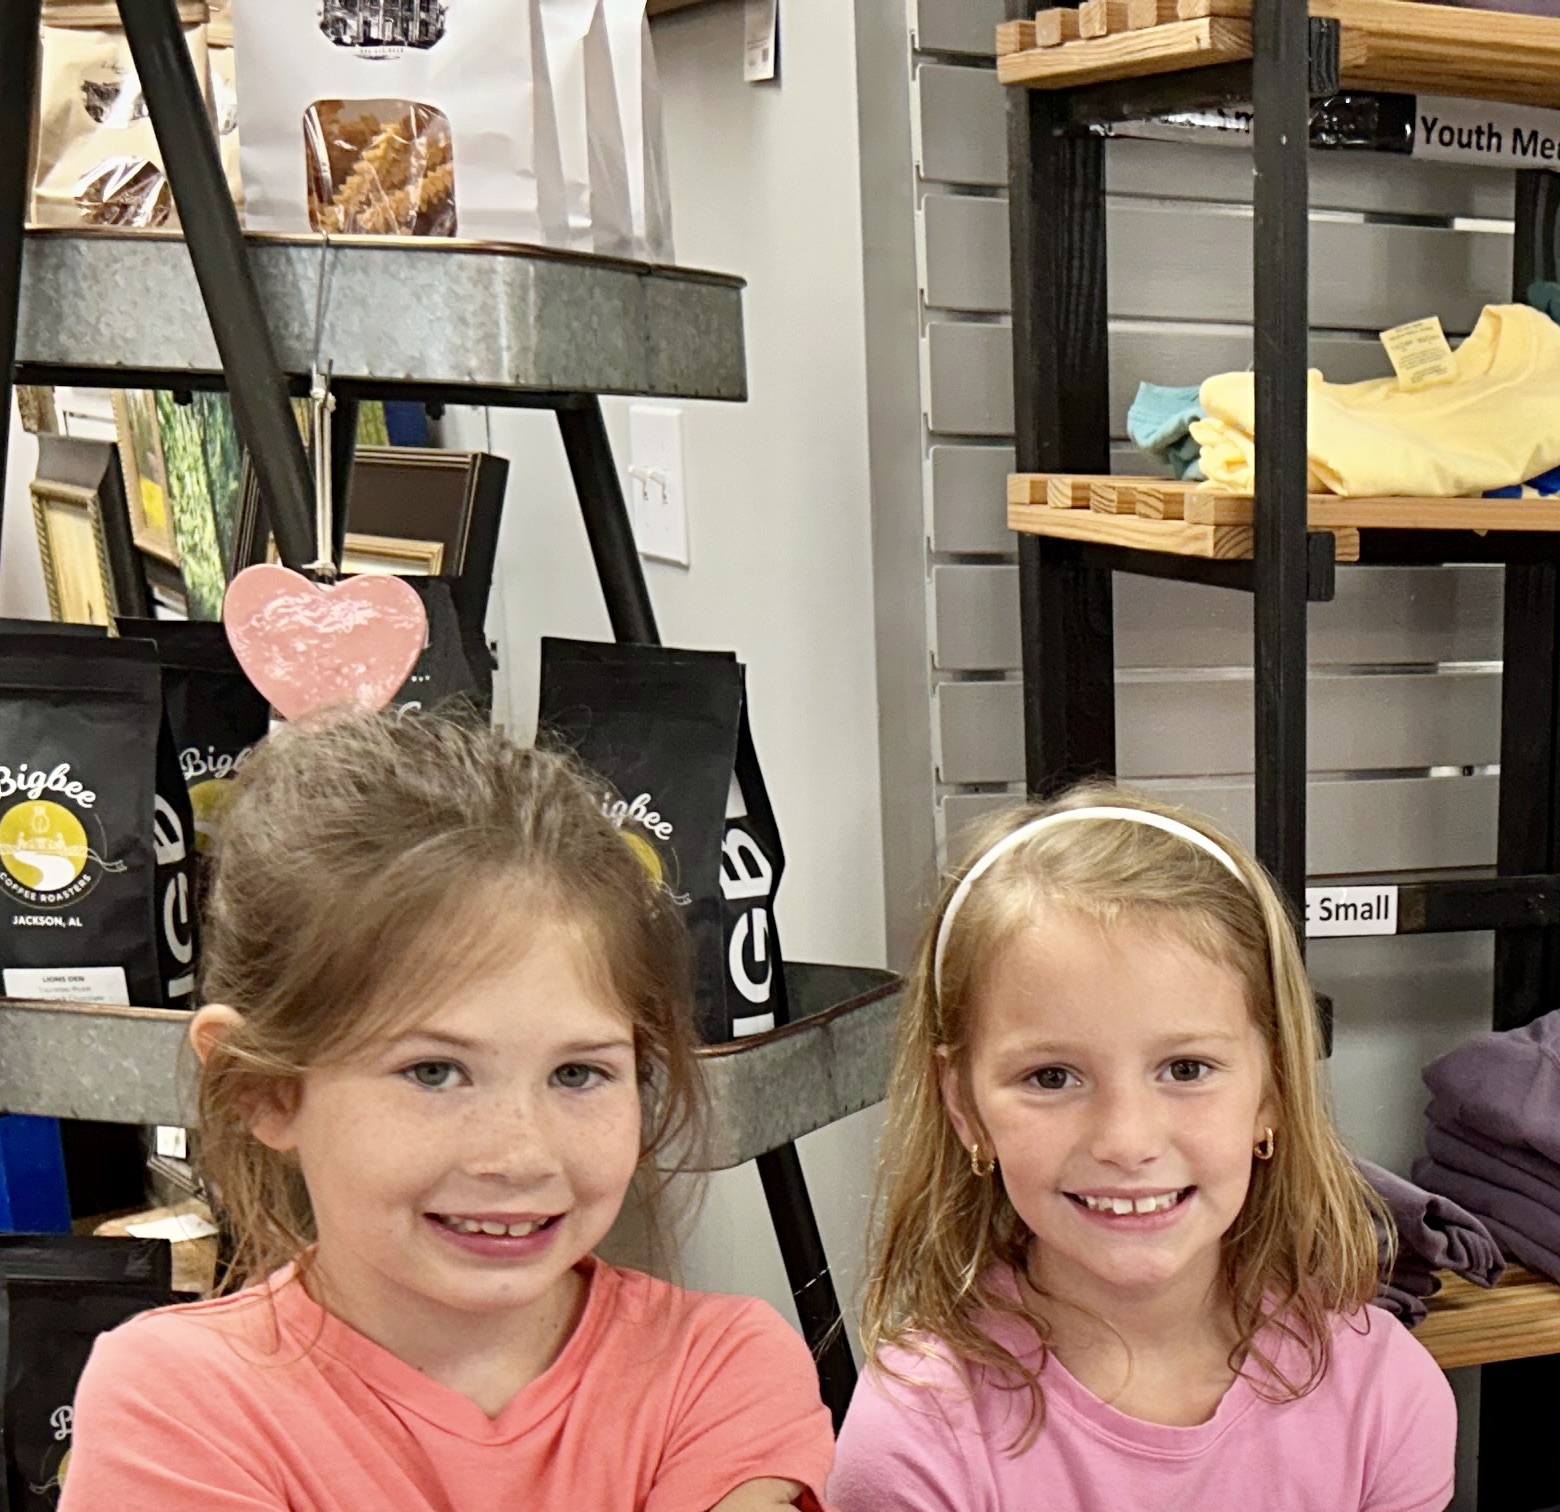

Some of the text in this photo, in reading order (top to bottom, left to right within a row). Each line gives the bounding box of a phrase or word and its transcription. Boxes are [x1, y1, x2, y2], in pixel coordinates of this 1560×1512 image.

[1420, 115, 1502, 153] Youth
[0, 763, 96, 808] Bigbee
[600, 792, 673, 840] igbee
[0, 871, 92, 903] COFFEE ROASTERS
[12, 915, 83, 929] JACKSON, AL
[1319, 894, 1390, 922] Small
